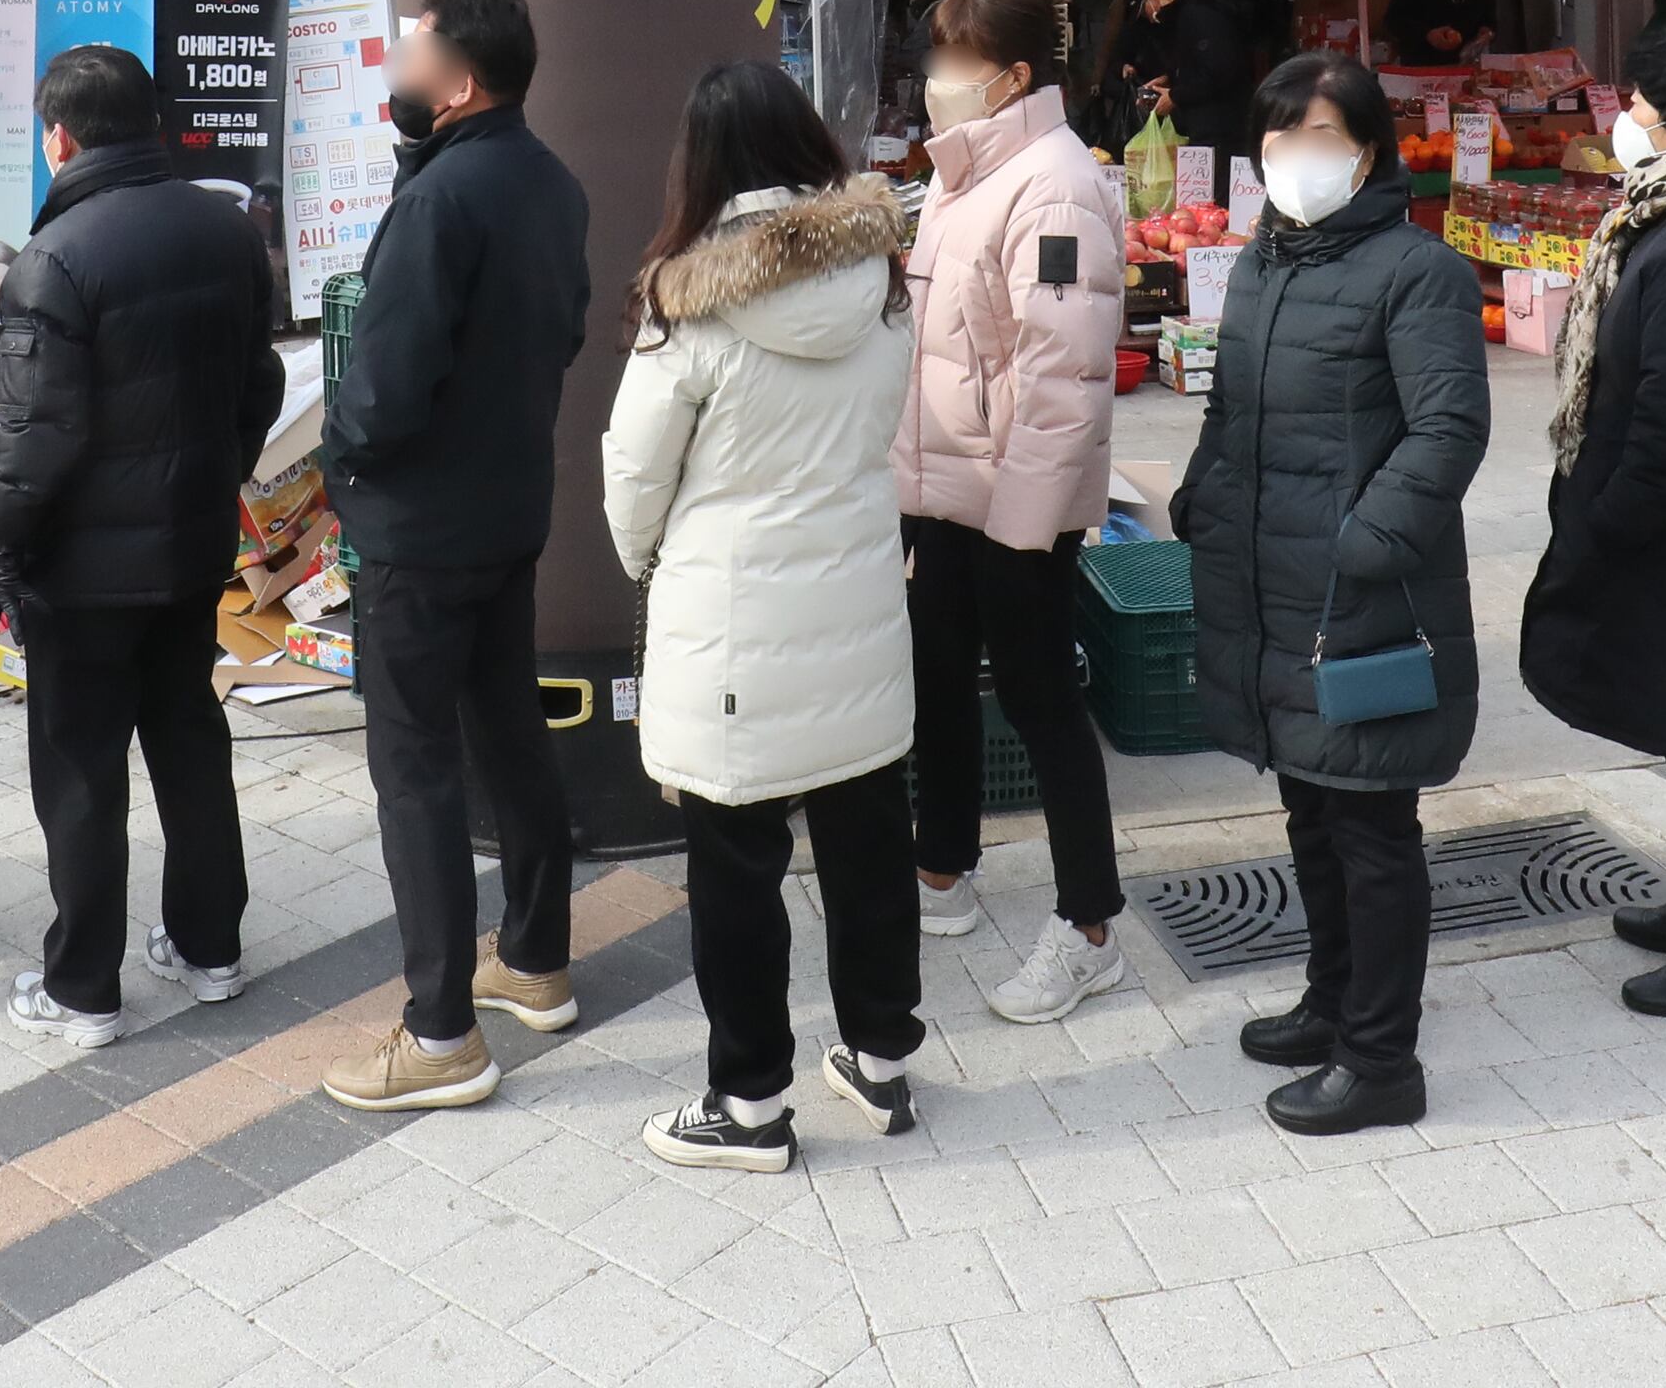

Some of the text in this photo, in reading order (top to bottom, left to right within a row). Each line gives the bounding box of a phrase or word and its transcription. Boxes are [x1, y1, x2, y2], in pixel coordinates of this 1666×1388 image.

[57, 0, 123, 13] ATOMY
[196, 3, 259, 15] DAYLONG
[177, 34, 276, 58] 아메리카노
[186, 62, 268, 89] 1,800원
[192, 112, 258, 129] 다크로스팅
[217, 131, 268, 148] 원두사용
[296, 147, 311, 158] TS
[615, 681, 637, 693] 카드
